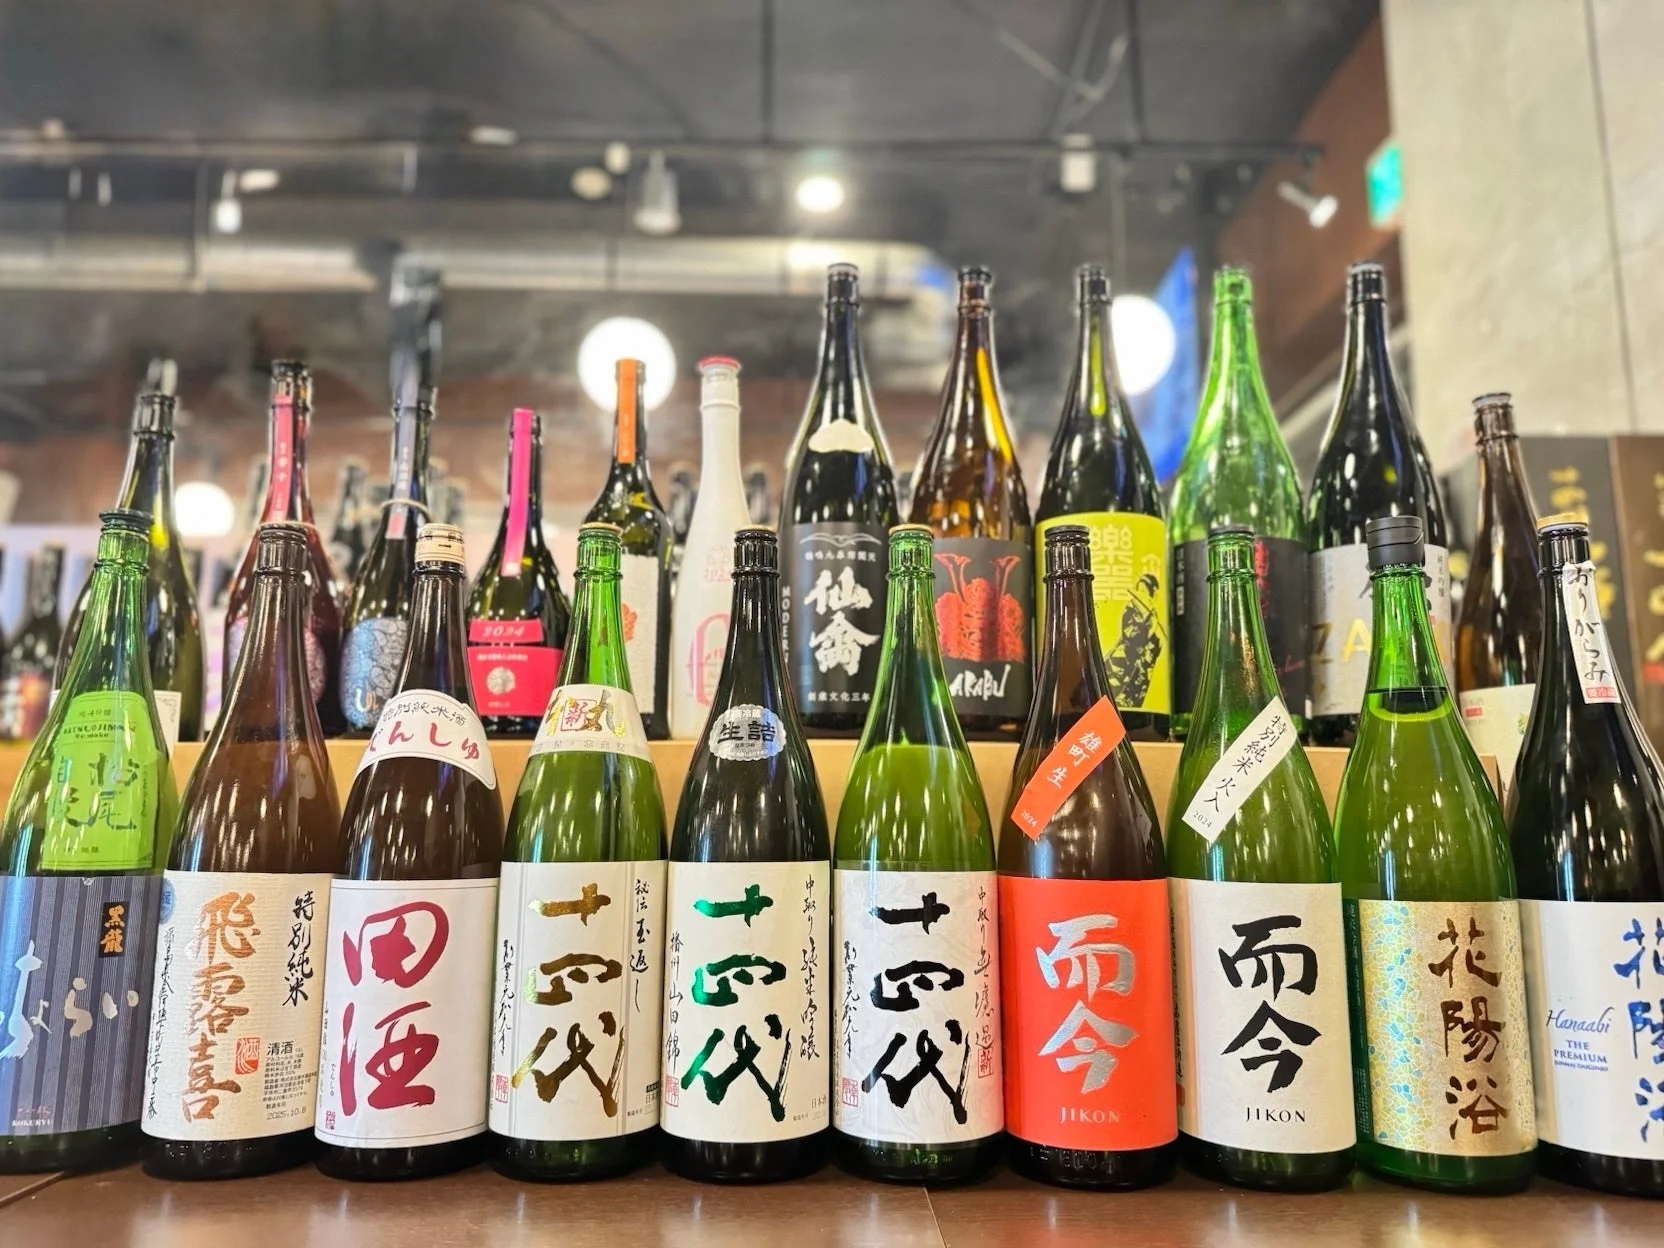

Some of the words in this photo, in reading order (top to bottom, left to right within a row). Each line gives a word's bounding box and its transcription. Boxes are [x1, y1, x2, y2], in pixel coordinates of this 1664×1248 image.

[483, 626, 525, 637] 2024
[1567, 565, 1611, 682] おりがらみ
[949, 664, 1011, 701] ARABU
[382, 701, 467, 727] 特別純米酒
[717, 721, 776, 744] 生詰
[1068, 730, 1102, 767] 雄町
[1232, 715, 1288, 776] 特別純米
[1047, 766, 1069, 788] 生
[1204, 777, 1236, 813] 火入
[1020, 809, 1037, 827] 2024
[1193, 810, 1213, 828] 2024
[101, 904, 125, 954] 黒龍
[282, 889, 316, 1007] 特別純米
[630, 878, 651, 1013] 秘伝玉返し
[0, 939, 140, 1060] ちょらい
[183, 891, 261, 1123] 飛露喜
[339, 901, 450, 1117] 田酒
[511, 882, 626, 1119] 十四代
[665, 931, 685, 1075] 播州山田錦
[681, 883, 793, 1122] 十四代
[861, 891, 970, 1125] 十四代
[1036, 914, 1140, 1095] 而今
[1218, 915, 1322, 1094] 而今
[1546, 1006, 1615, 1034] Hanaabi
[266, 1040, 294, 1056] 清酒
[1428, 916, 1508, 1140] 花陽浴
[1565, 1039, 1590, 1050] THE
[1553, 1048, 1608, 1063] PREMIUM
[1060, 1106, 1120, 1124] JIKON
[1246, 1106, 1306, 1123] JIKON
